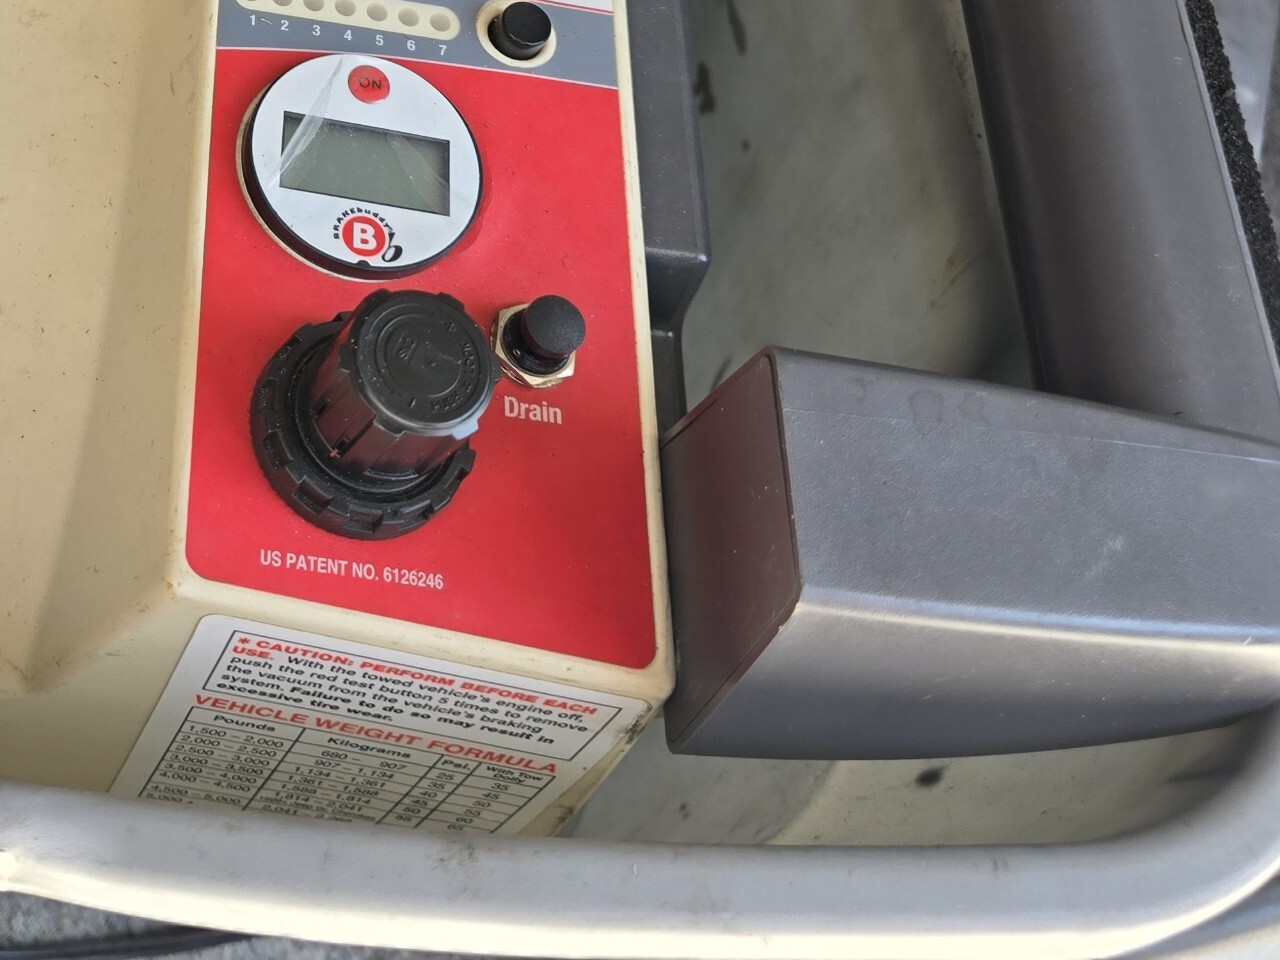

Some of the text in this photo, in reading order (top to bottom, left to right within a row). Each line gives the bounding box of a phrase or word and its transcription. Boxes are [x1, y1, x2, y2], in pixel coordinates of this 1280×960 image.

[249, 14, 448, 56] 1 2 3 4 5 6 7
[359, 77, 382, 91] ON
[353, 222, 377, 251] B
[504, 395, 562, 424] Drain
[260, 548, 445, 590] US PATENT NO. 6126246
[230, 656, 589, 732] push the red test button 5 times to remove
[232, 646, 584, 724] USE. With the towed vehicle's engine off,
[256, 640, 598, 716] CAUTION: PERFORM BEFORE EACH
[215, 682, 395, 723] excessive tire wear.
[220, 672, 556, 745] system. Failure to do so may result in
[226, 665, 544, 735] the vacuum from the vehicle's braking
[194, 694, 557, 774] VEHICLE WEIGHT FORMULA
[213, 715, 277, 732] Pounds
[327, 737, 412, 759] Kilograms
[517, 771, 544, 783] Tow
